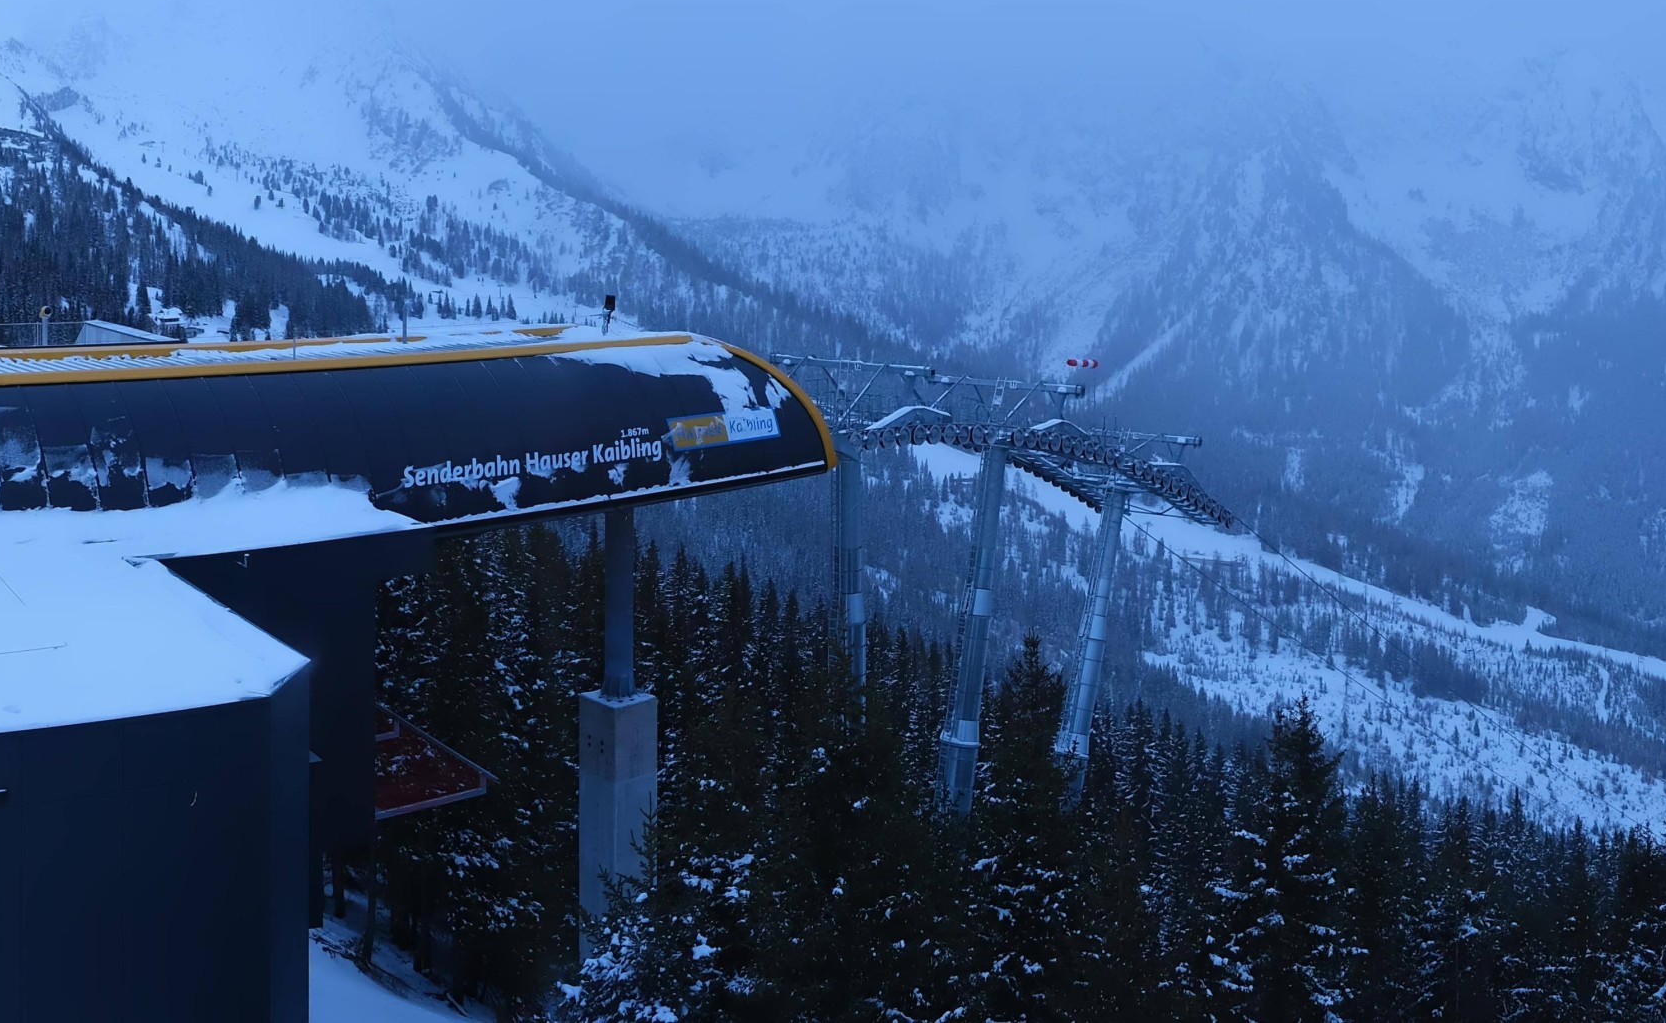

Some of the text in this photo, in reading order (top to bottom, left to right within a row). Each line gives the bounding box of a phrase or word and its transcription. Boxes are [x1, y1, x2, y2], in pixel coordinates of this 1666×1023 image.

[621, 427, 649, 437] 1.867m
[403, 438, 662, 488] Senderbahn Hauser Kaibling
